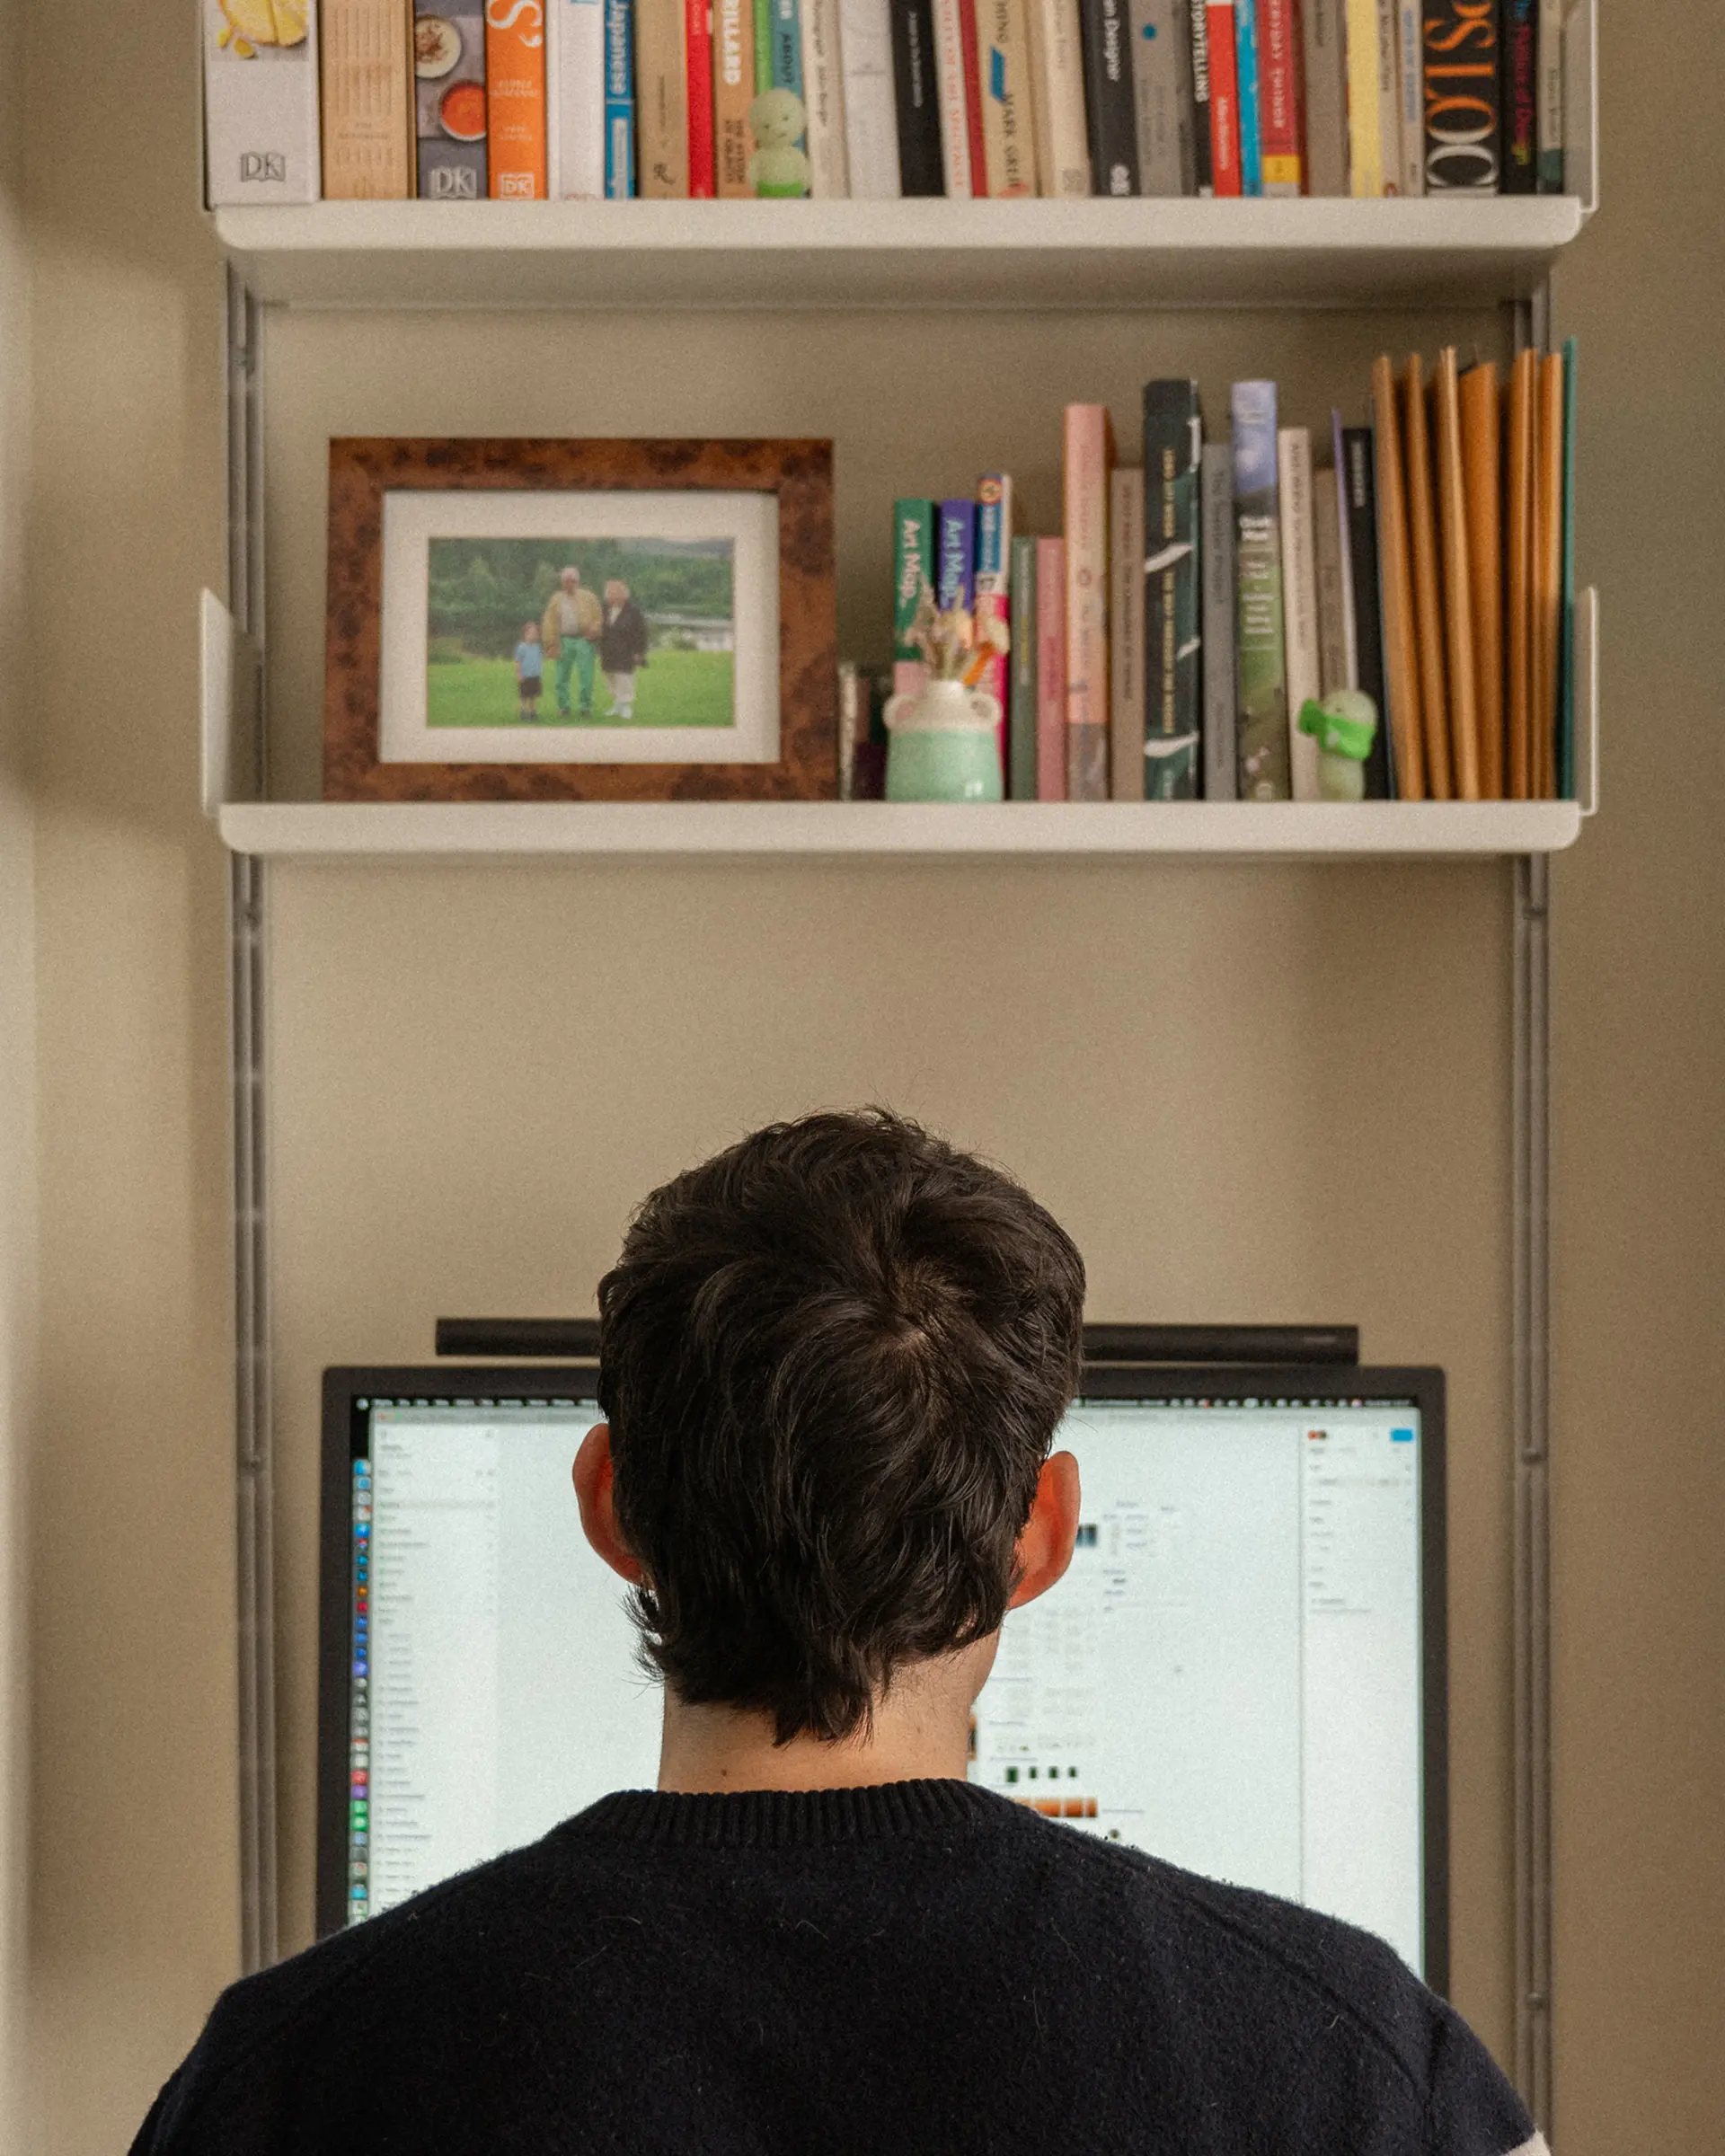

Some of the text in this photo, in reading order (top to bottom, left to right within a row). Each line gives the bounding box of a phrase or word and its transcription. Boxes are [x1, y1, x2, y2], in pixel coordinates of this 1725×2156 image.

[606, 0, 627, 95] Japanese
[781, 33, 794, 84] ABOUT
[1104, 18, 1120, 82] Designer
[1002, 93, 1014, 137] MARK
[1271, 67, 1285, 128] THINGS
[1510, 108, 1532, 165] Design
[244, 155, 283, 179] DK
[437, 167, 473, 194] DK
[502, 177, 532, 197] DK
[901, 519, 921, 548] Art
[946, 519, 965, 548] Art
